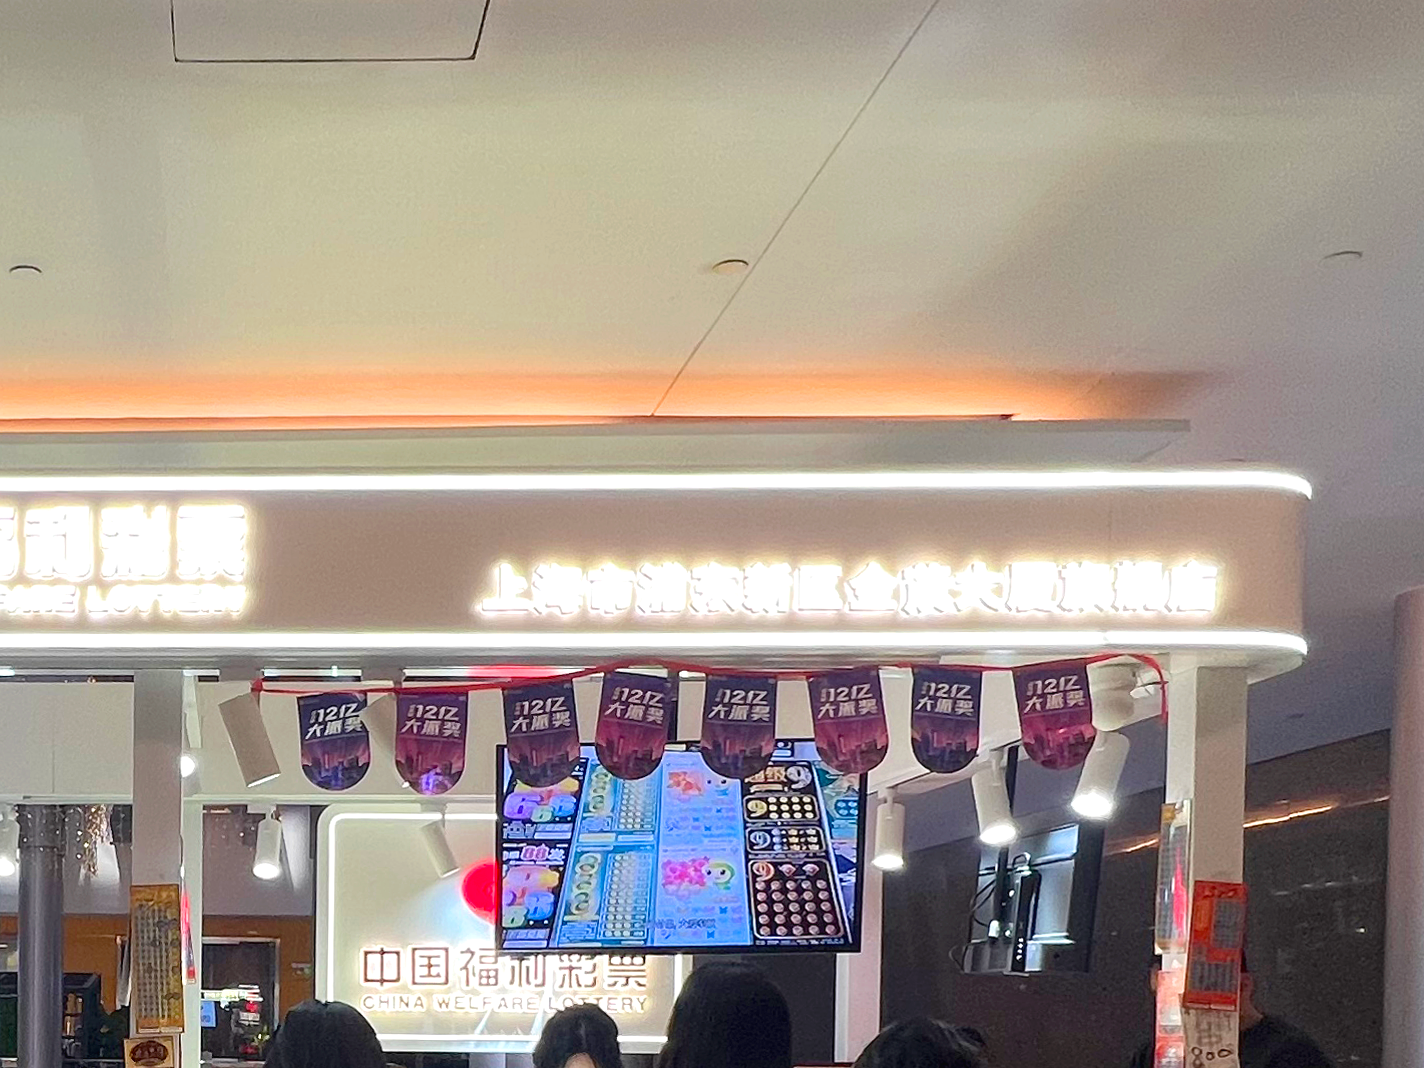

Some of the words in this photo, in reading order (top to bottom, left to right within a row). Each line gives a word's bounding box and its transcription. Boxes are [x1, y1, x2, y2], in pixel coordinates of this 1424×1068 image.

[87, 585, 247, 617] LOTTERY
[363, 947, 648, 988] 中国福利彩票
[363, 995, 425, 1011] CHINA
[436, 995, 541, 1011] WELFARE
